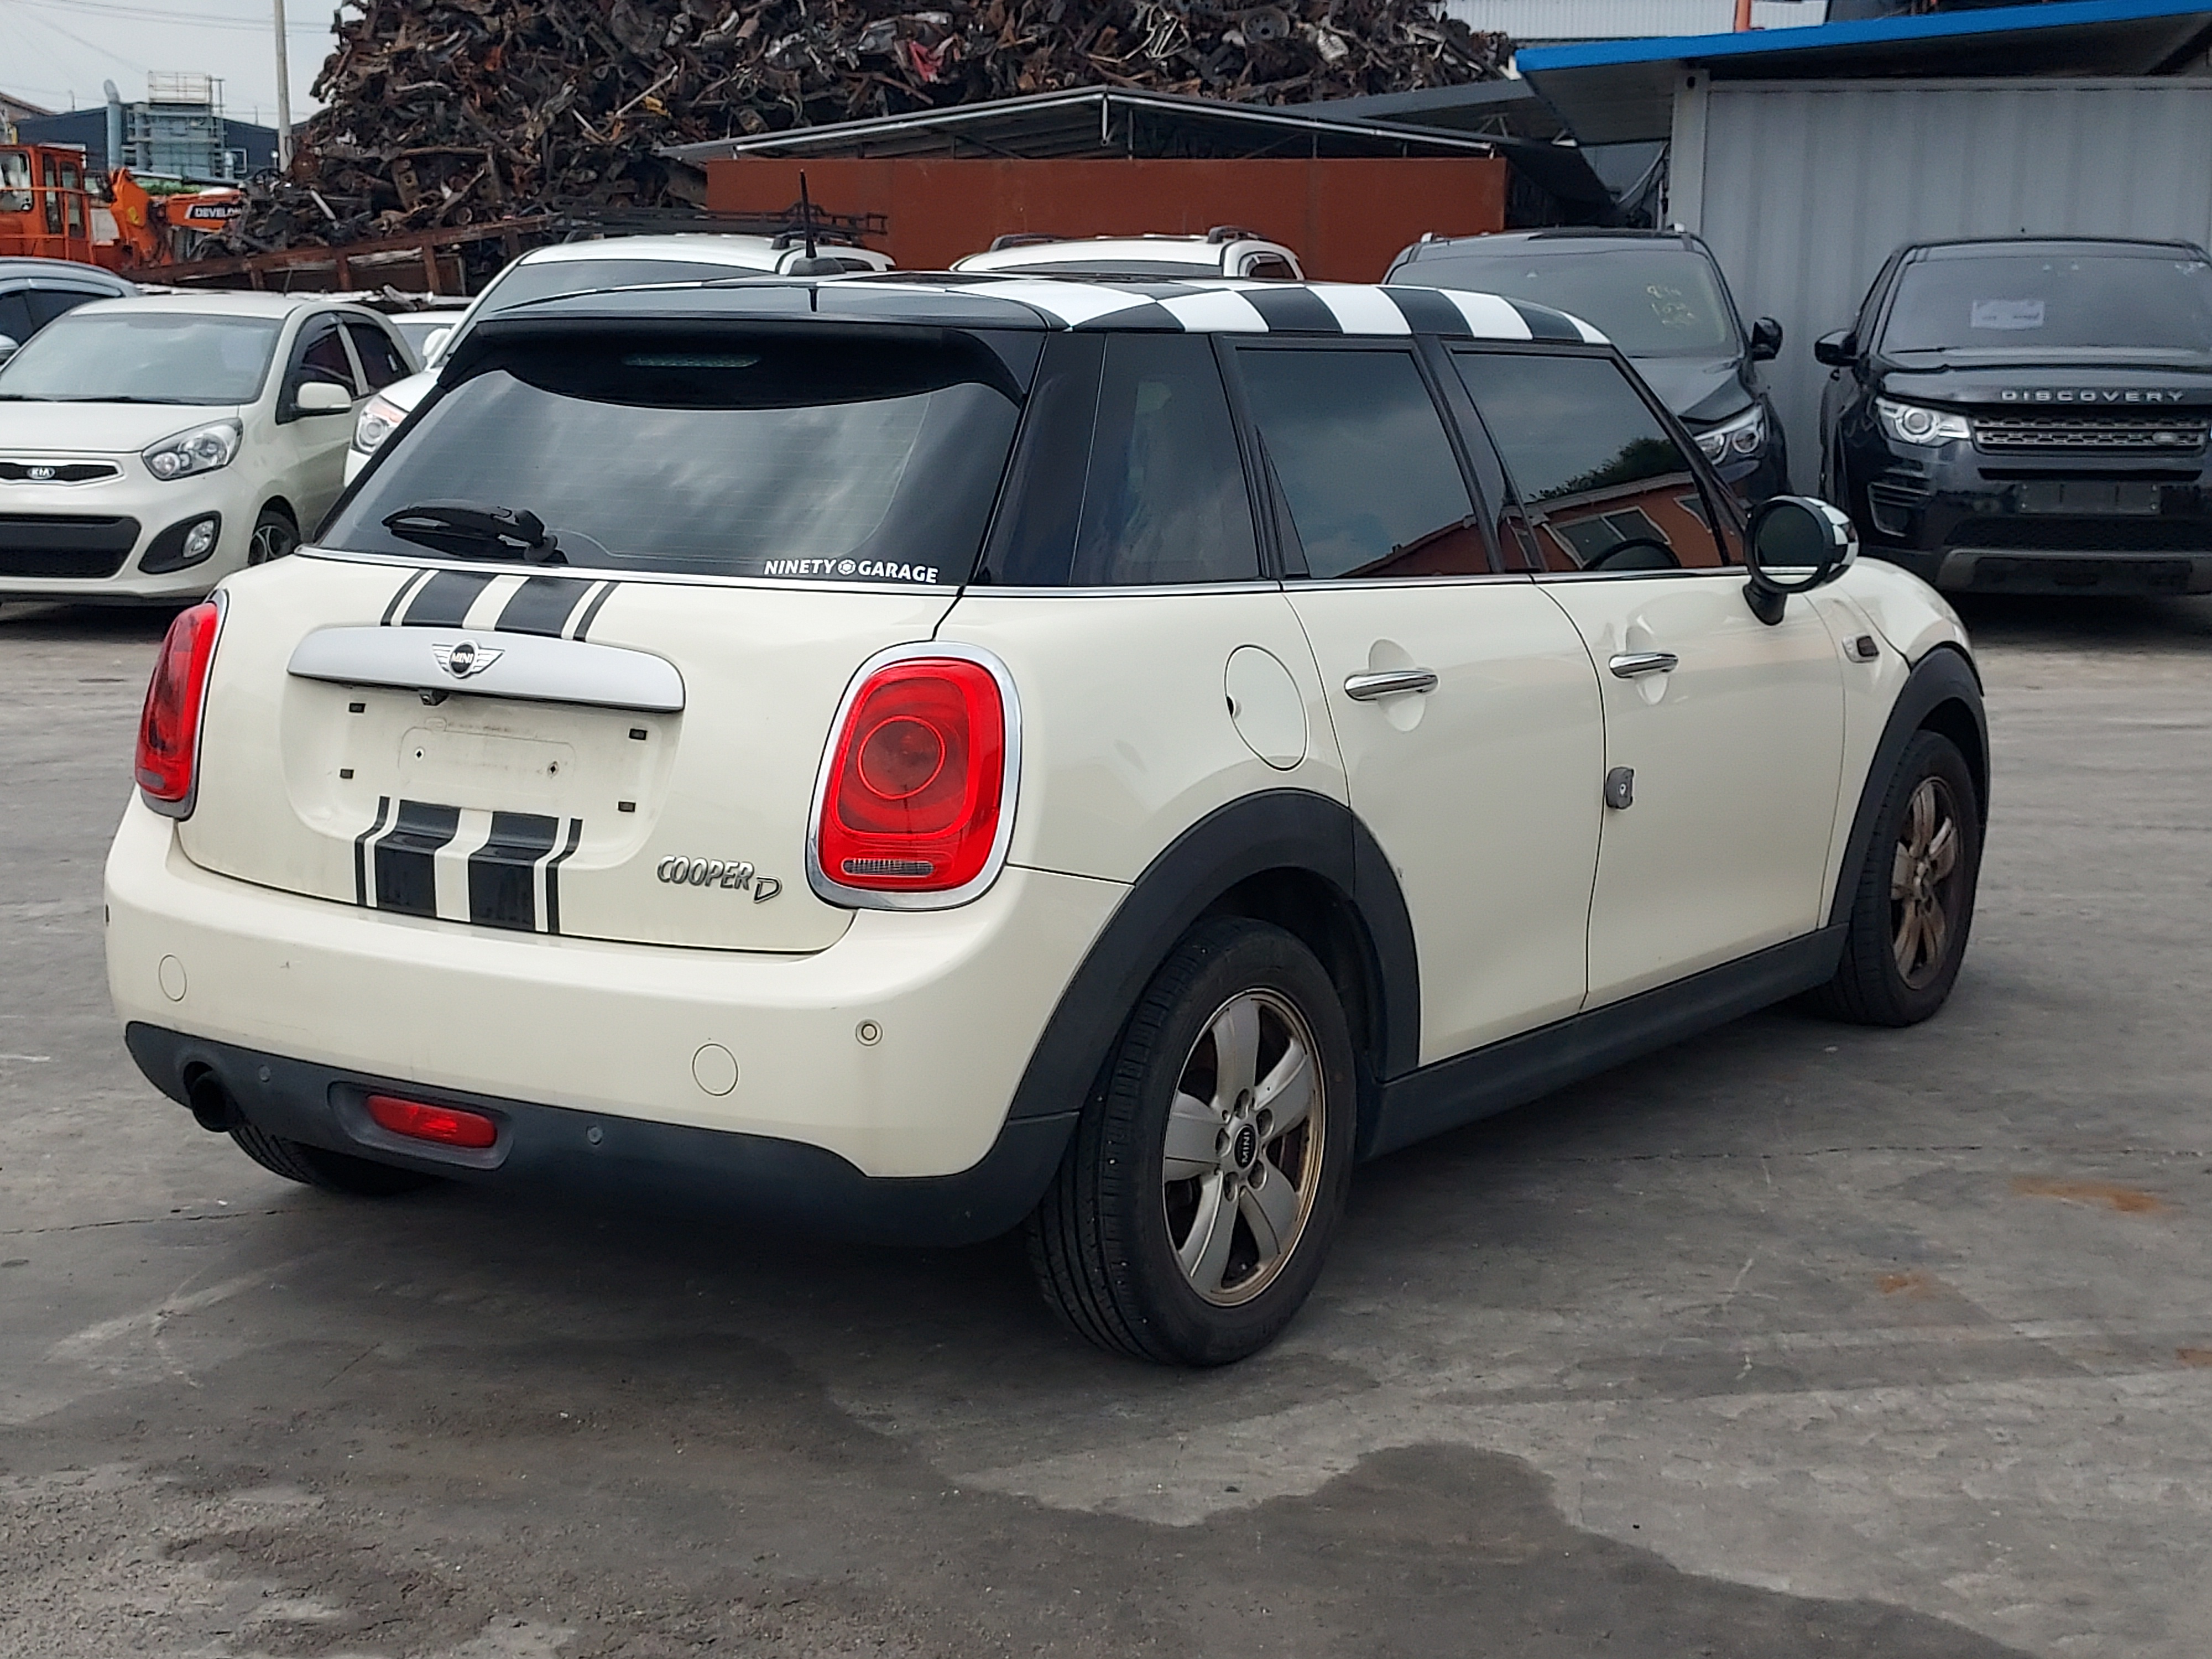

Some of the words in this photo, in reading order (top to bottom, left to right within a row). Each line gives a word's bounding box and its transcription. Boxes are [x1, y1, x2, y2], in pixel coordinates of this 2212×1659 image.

[2001, 390, 2184, 402] DISCOVERY
[764, 559, 837, 575] NINETY
[858, 560, 938, 583] GARAGE
[452, 652, 474, 664] MINI
[657, 855, 755, 891] COOPER
[753, 875, 782, 904] D
[1241, 1131, 1250, 1165] MINI
